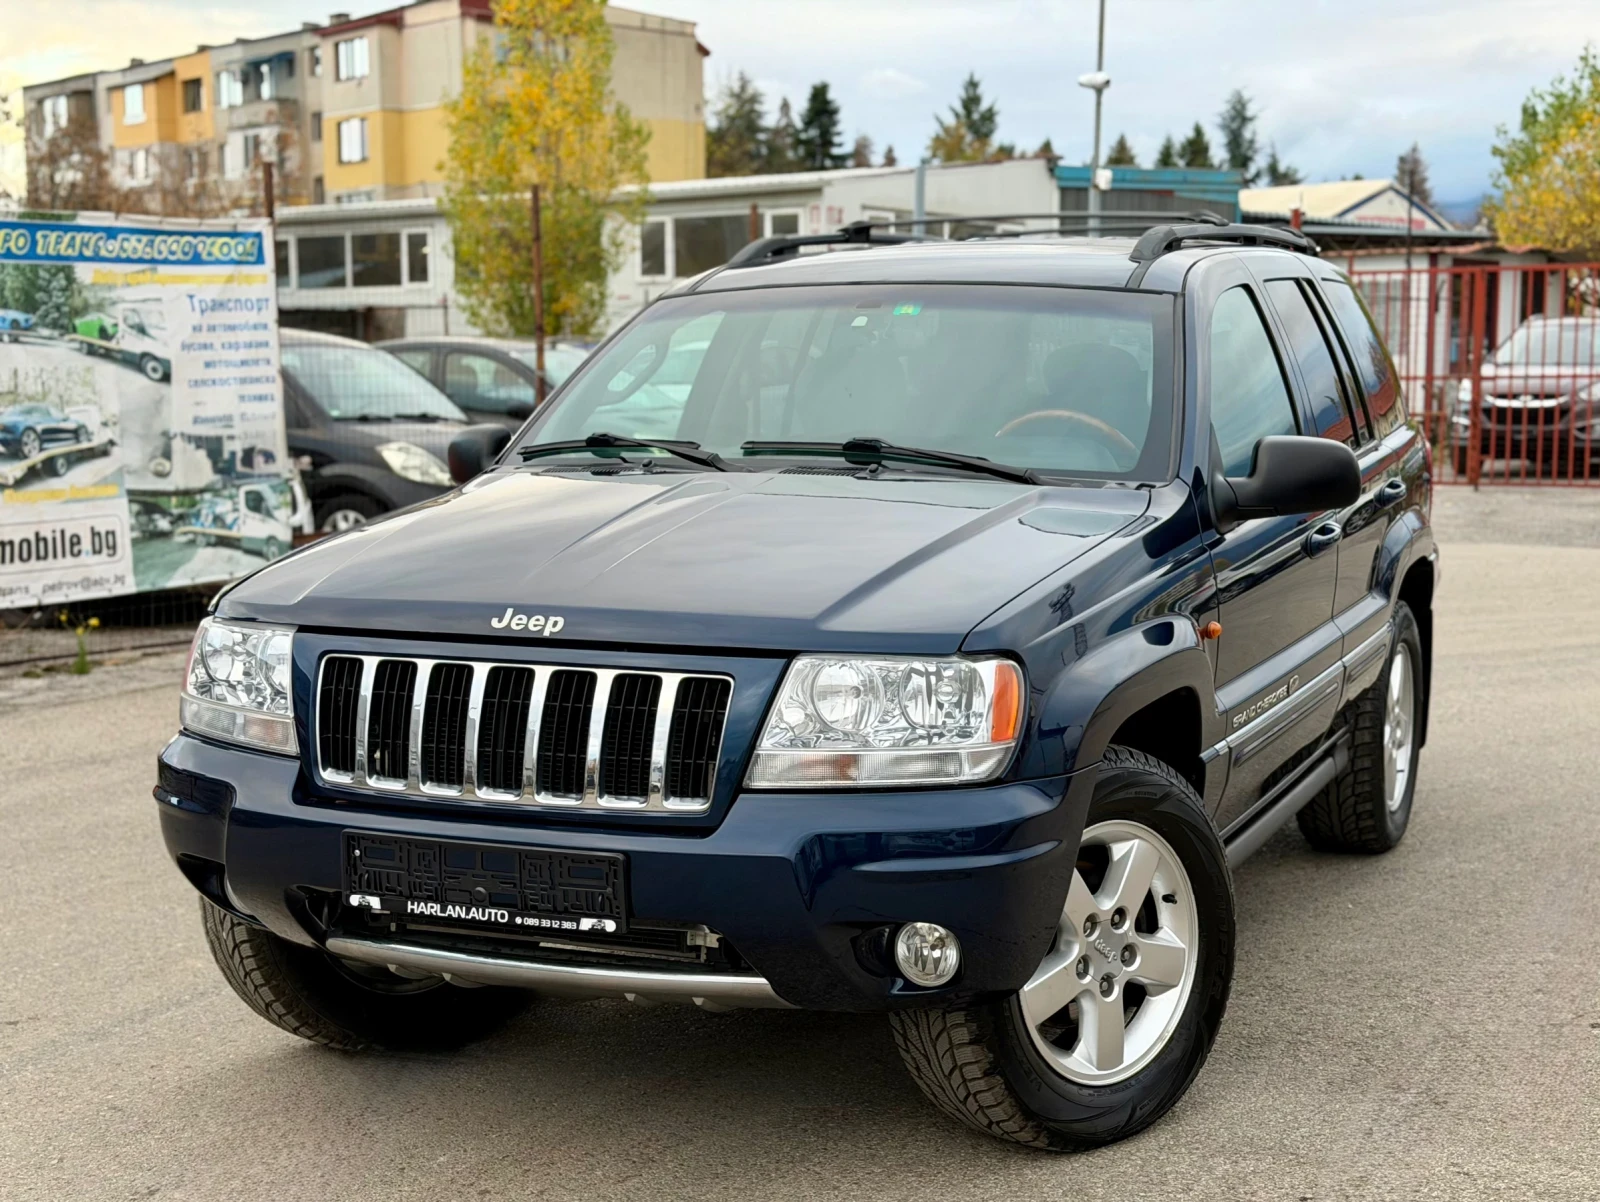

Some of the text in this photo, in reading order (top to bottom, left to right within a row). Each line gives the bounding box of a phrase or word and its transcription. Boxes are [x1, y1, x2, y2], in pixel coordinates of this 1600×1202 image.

[187, 294, 270, 315] Транспорт
[0, 525, 117, 565] mobile.bg
[490, 607, 565, 637] Jeep
[407, 900, 509, 923] HARLAN.AUTO
[523, 917, 577, 930] 089 33 12 383
[1094, 939, 1118, 963] Jeep
